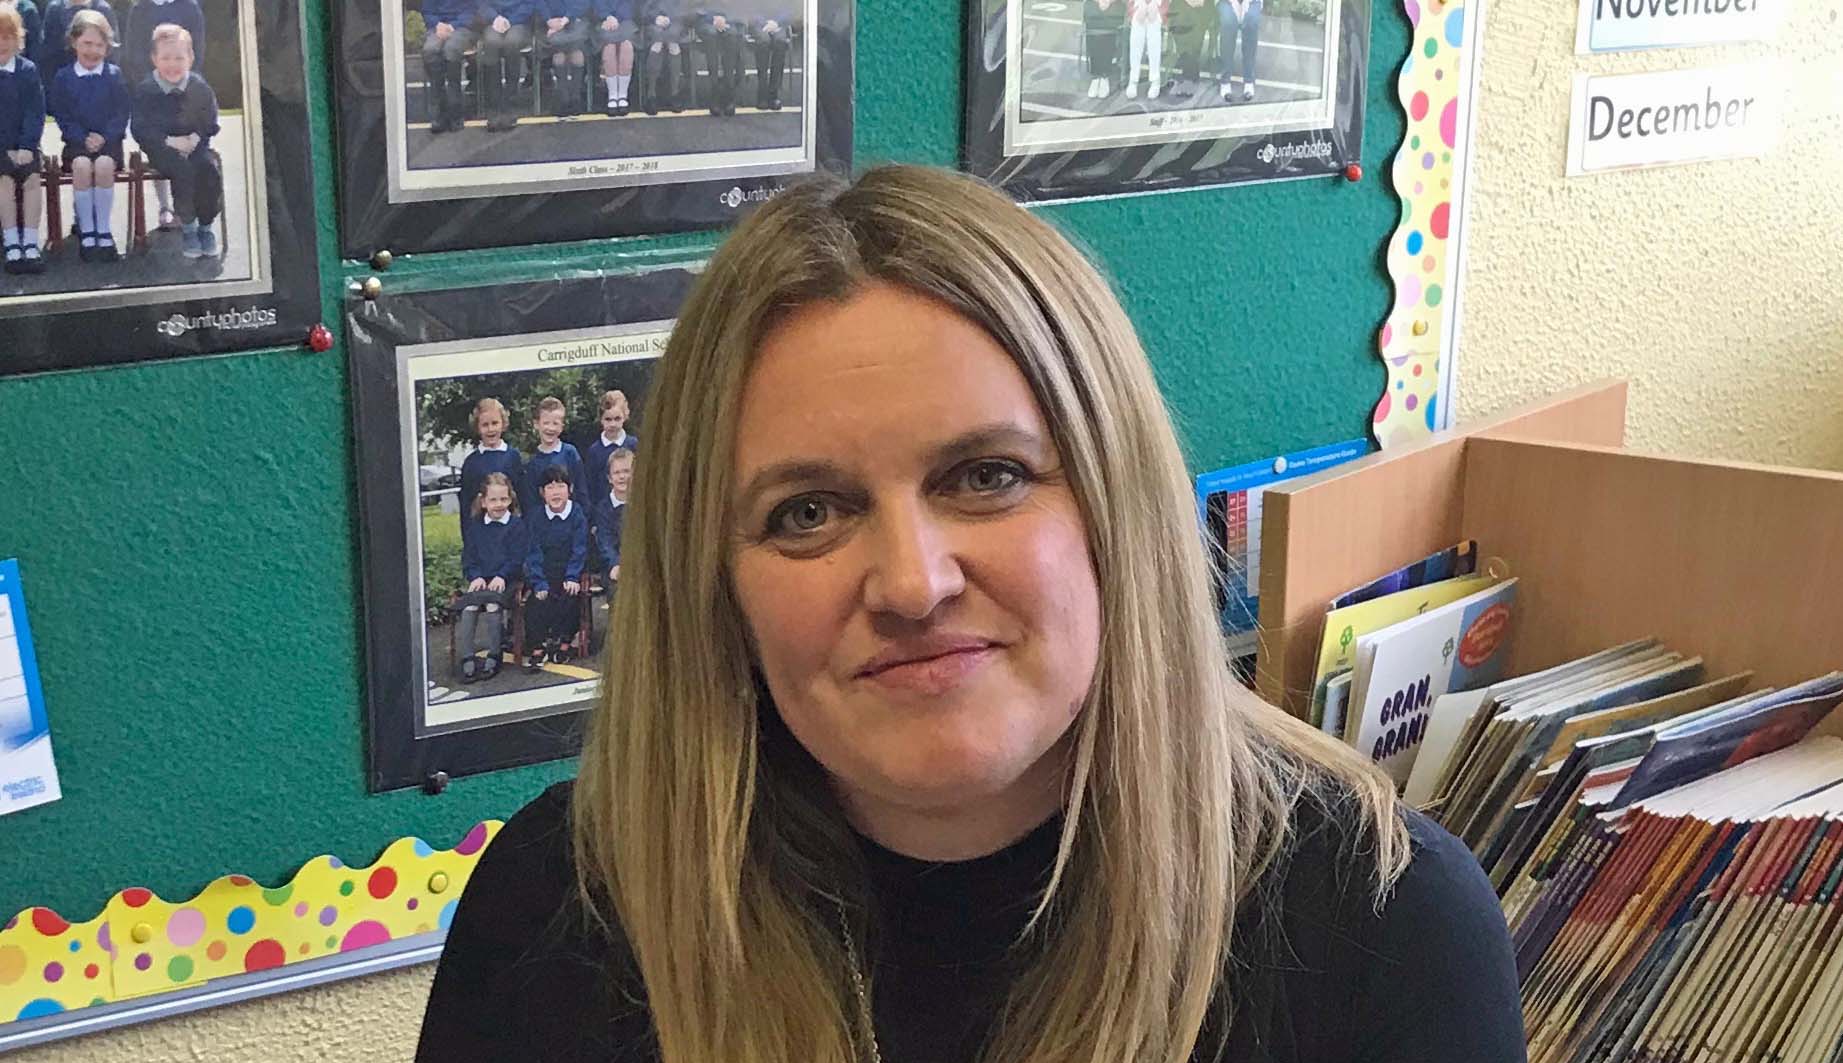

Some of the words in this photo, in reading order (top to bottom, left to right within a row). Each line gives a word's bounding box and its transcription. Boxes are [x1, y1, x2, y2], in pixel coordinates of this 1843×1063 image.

[1588, 86, 1755, 141] December
[1256, 139, 1333, 163] countyphotos
[157, 305, 277, 336] countyphotos
[537, 343, 599, 362] Carrigduff
[601, 339, 649, 357] National
[652, 338, 669, 351] Sc
[1380, 673, 1432, 727] GRAN,
